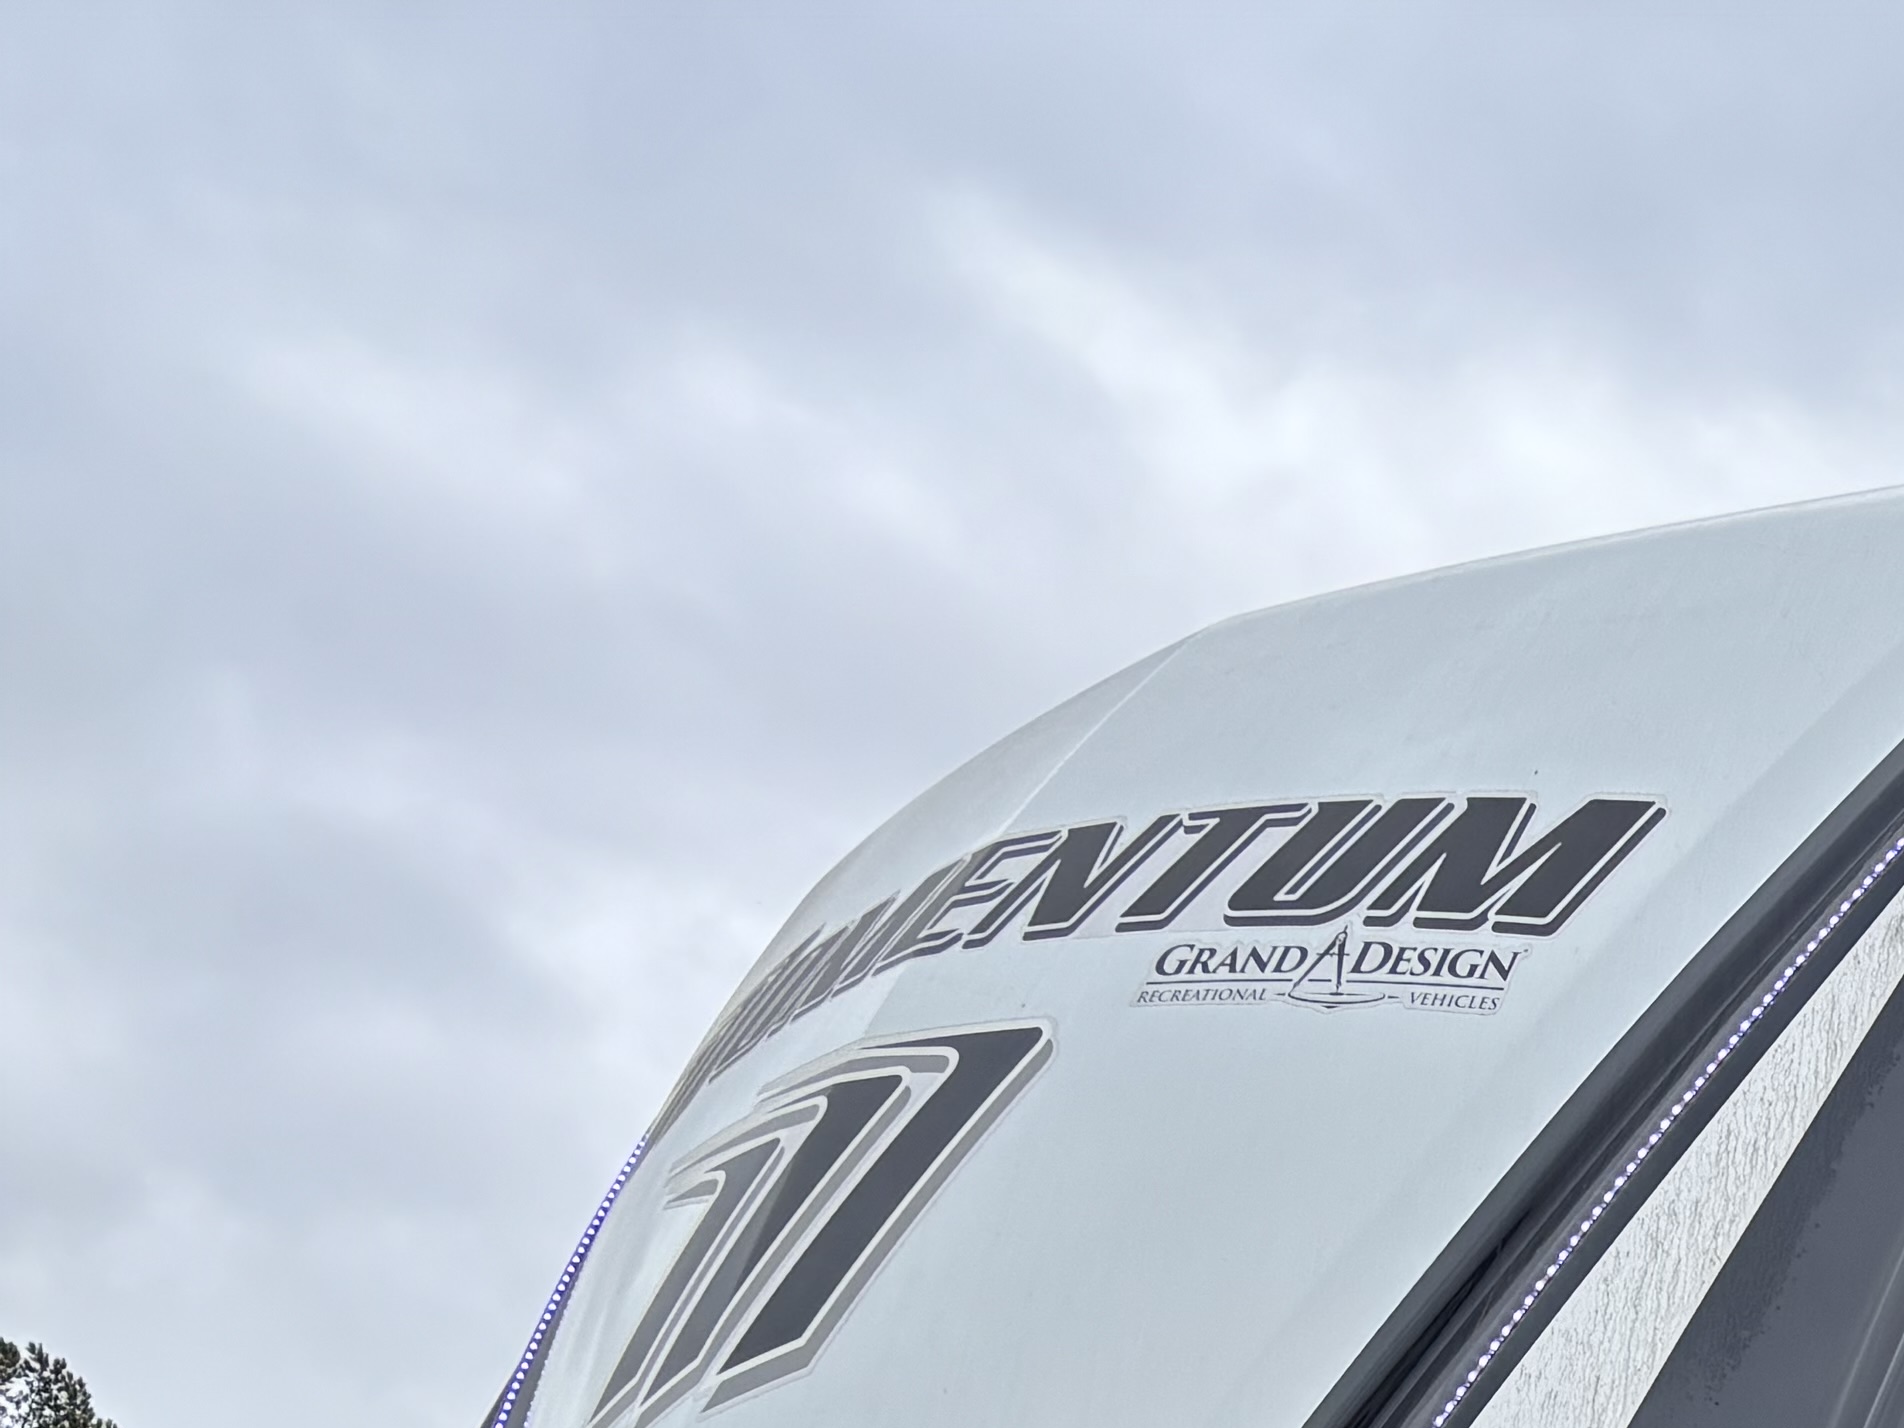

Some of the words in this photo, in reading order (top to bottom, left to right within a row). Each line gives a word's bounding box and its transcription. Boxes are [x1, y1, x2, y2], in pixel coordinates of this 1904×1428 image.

[1154, 943, 1309, 977] GRAND
[1349, 940, 1522, 982] DESIGN
[1137, 987, 1268, 1005] RECREATIONAL
[1409, 991, 1501, 1011] VEHICLES
